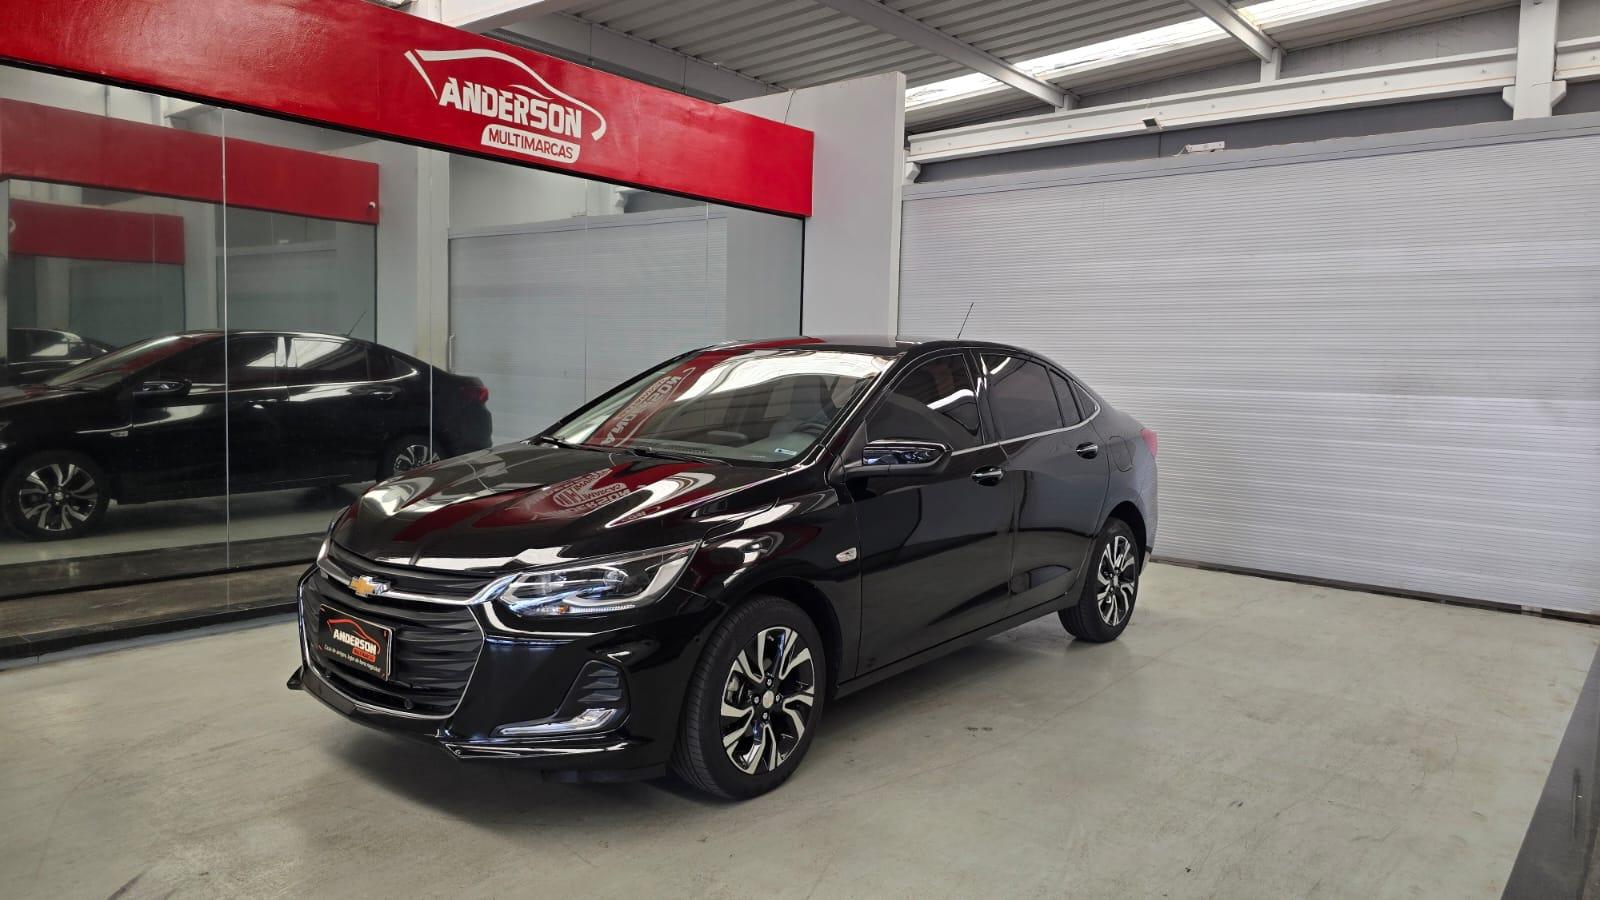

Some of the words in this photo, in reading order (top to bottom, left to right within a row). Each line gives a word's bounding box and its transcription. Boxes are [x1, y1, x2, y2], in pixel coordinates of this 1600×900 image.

[439, 77, 582, 139] ANDERSON
[488, 127, 574, 159] MULTIMARCAS
[333, 628, 377, 656] ANDERSON
